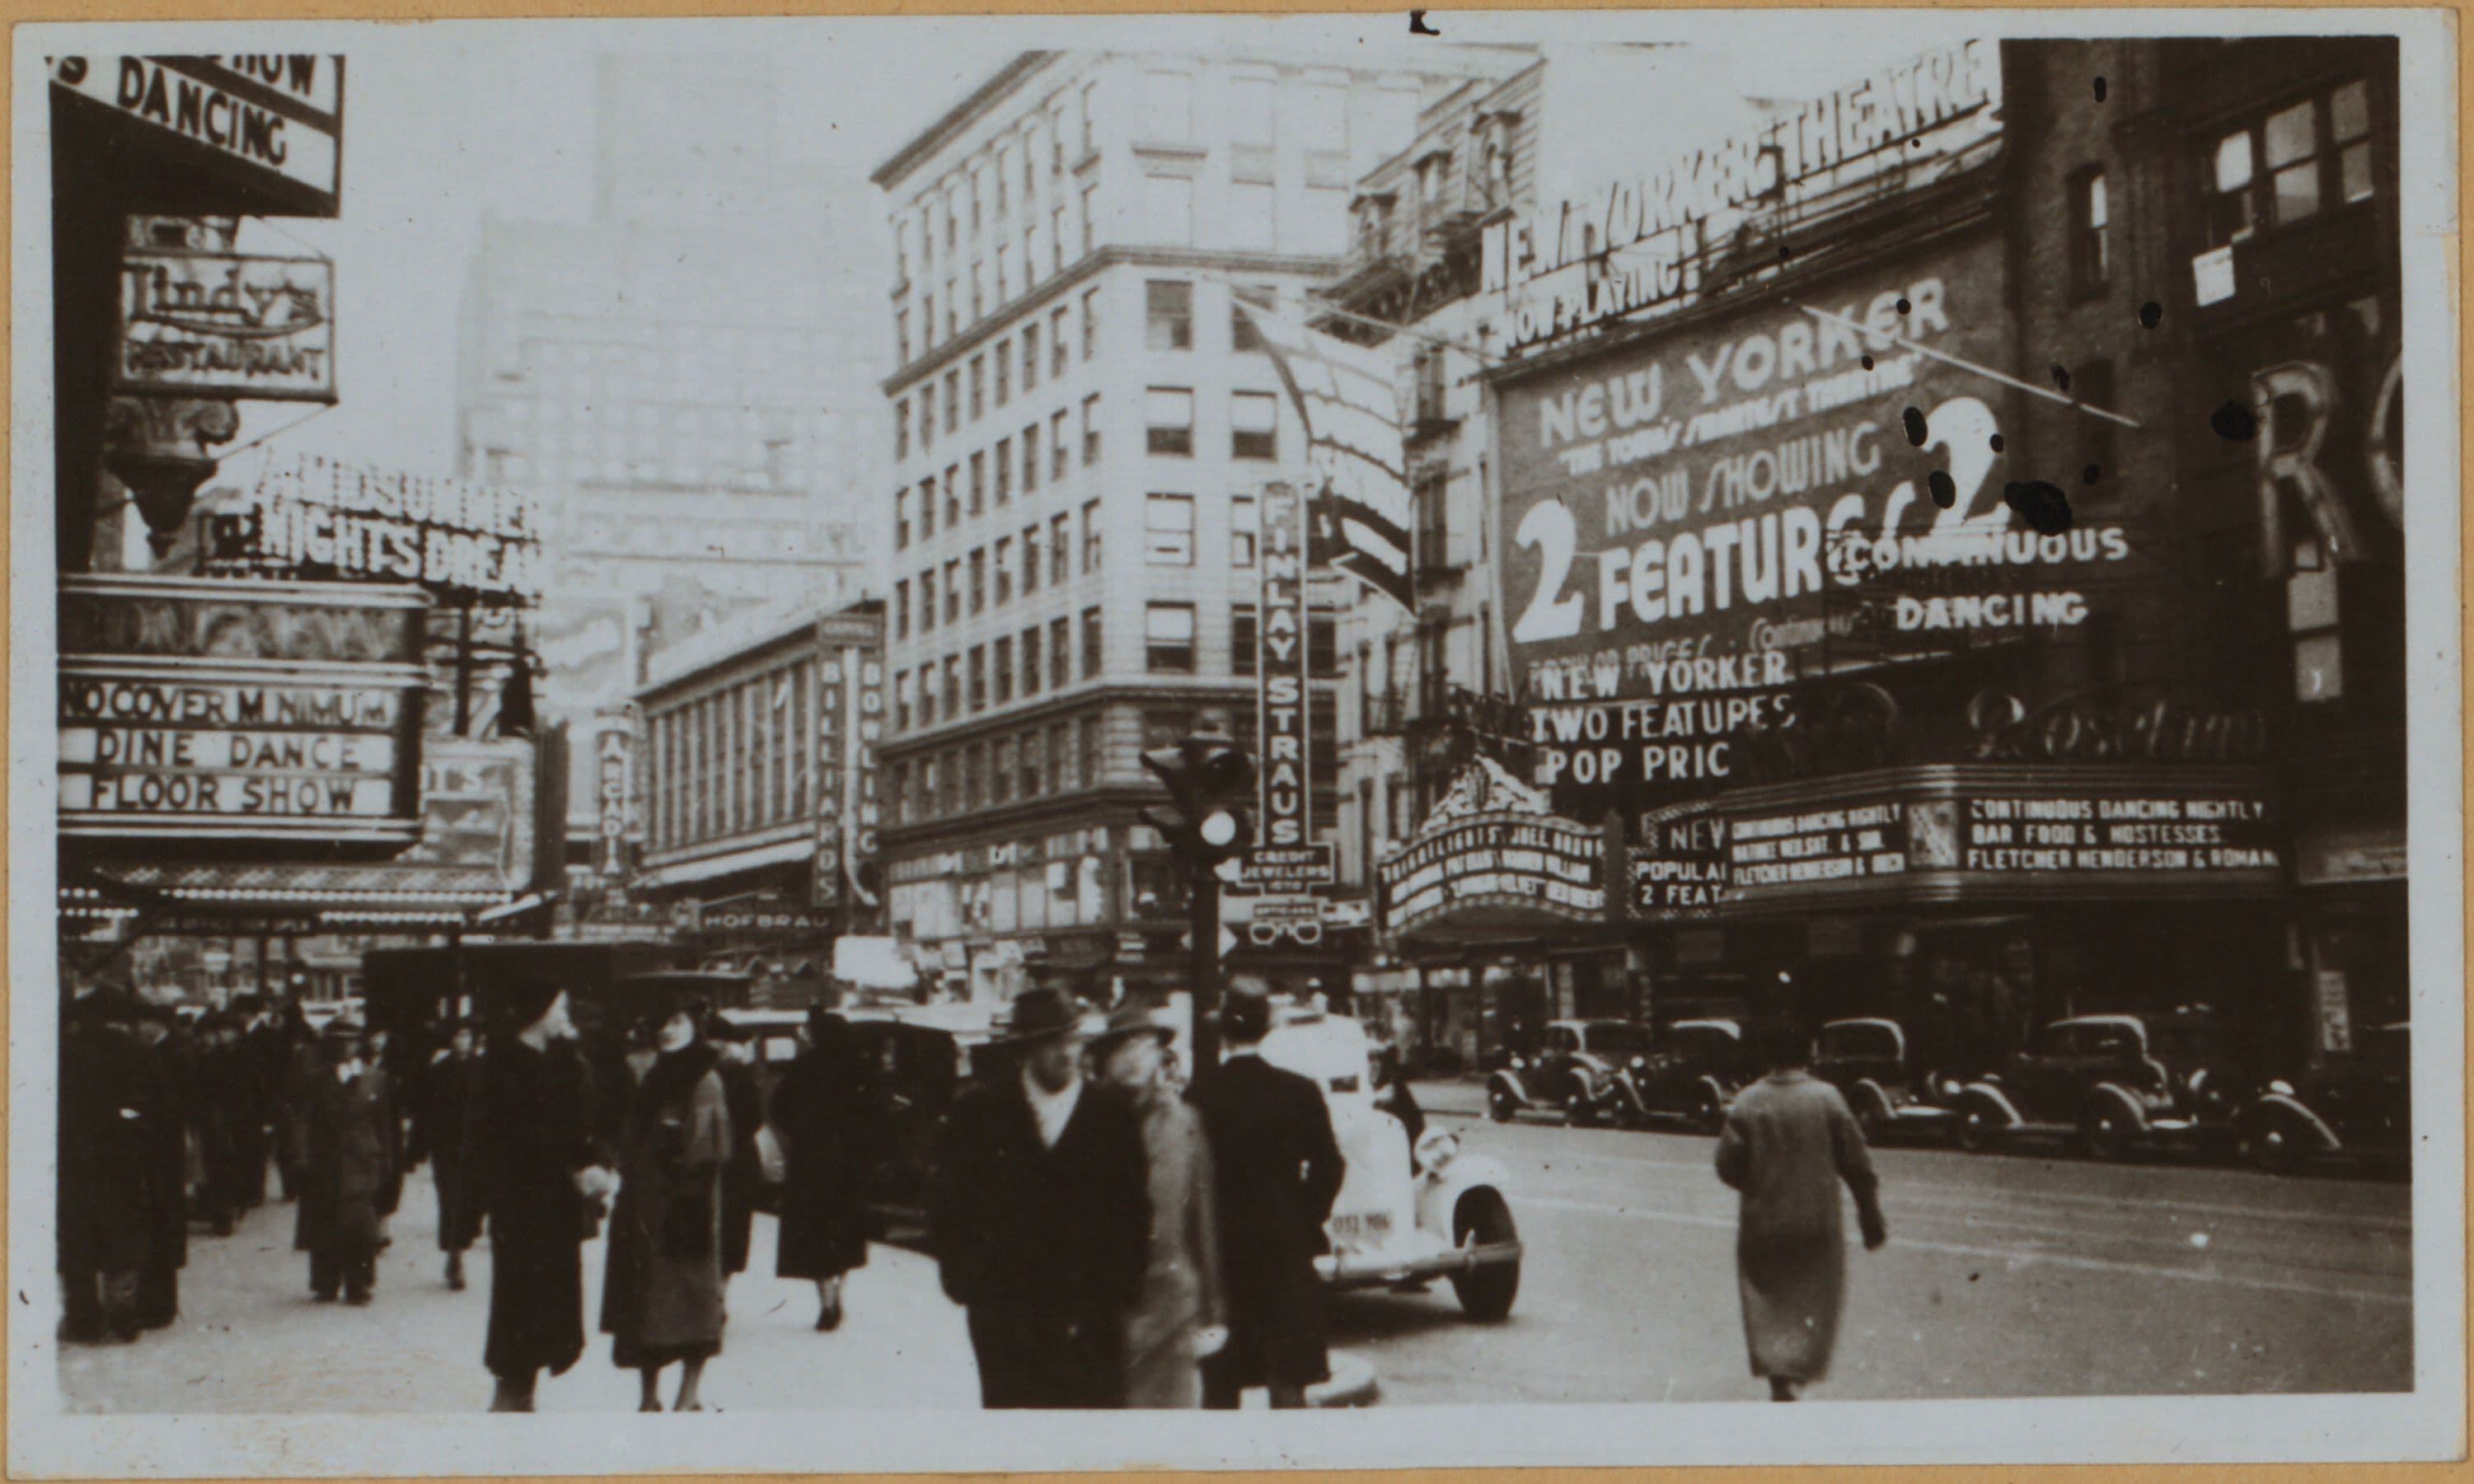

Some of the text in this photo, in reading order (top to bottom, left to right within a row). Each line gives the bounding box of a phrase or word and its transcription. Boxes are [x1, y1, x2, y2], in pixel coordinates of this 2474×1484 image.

[117, 54, 286, 165] DANCING
[128, 334, 326, 381] RESTAURANT
[1540, 277, 1950, 450] NEW YORKER
[1605, 419, 1882, 536] NOW SHOWING
[260, 501, 421, 579] NIGHTS
[1512, 498, 1586, 643] 2
[1916, 396, 2011, 540] 2
[1264, 493, 1297, 662] FINLAY
[1893, 591, 2090, 632] DANCING
[1540, 663, 1622, 700] NEW
[1648, 649, 1788, 695] YORKER
[110, 683, 228, 724] COVER
[237, 690, 391, 728] MNIMUM
[1530, 707, 1608, 742] TWO
[96, 731, 362, 770] DINE DANCE
[861, 661, 883, 854] BOWLING
[1266, 676, 1301, 845] STRAUS
[1545, 747, 1623, 785] POP
[91, 773, 354, 816] FLOOR SHOW
[818, 659, 841, 896] BILLIARDS
[1970, 799, 2265, 819] CONTINUOUS DANCING NIGHTLY
[1972, 823, 2012, 845] BAR
[2024, 823, 2076, 845] FOOD
[1242, 865, 1330, 879] JEWELERS
[1253, 850, 1316, 864] CREDIT
[1967, 849, 2072, 869] FLETCHER
[2077, 849, 2187, 869] HENDERSON
[1641, 884, 1654, 905] 2
